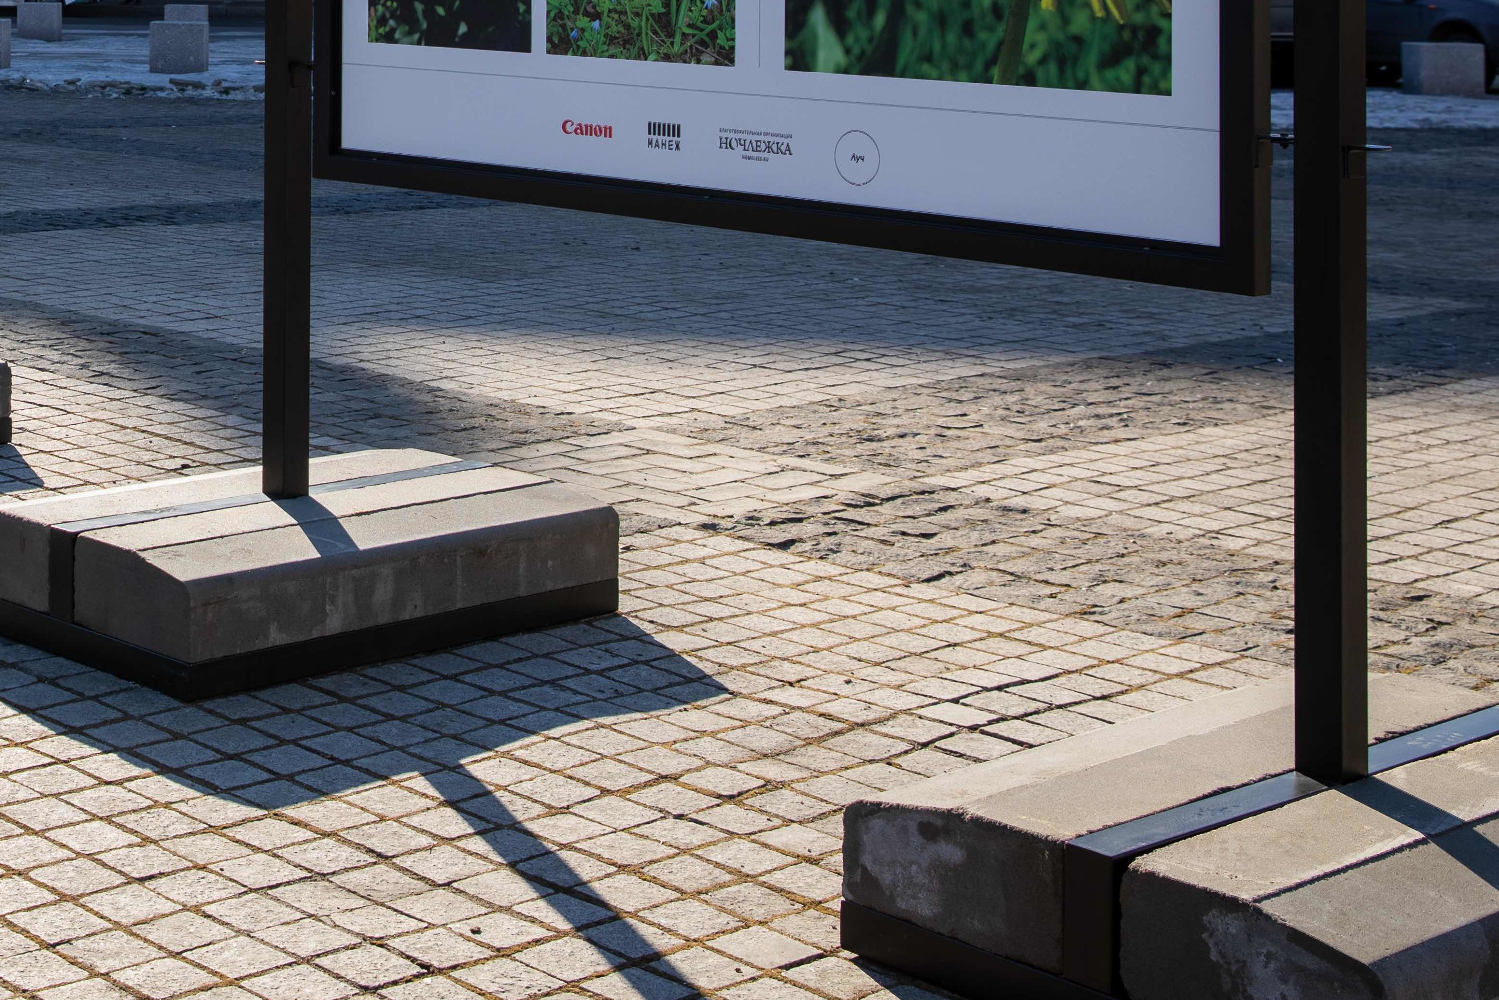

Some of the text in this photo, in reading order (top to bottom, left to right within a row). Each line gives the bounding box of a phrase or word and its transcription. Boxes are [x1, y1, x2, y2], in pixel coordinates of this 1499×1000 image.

[561, 118, 613, 139] Canon
[647, 137, 681, 152] МАНЕЖ
[718, 135, 794, 156] НОЧЛЕЖКА
